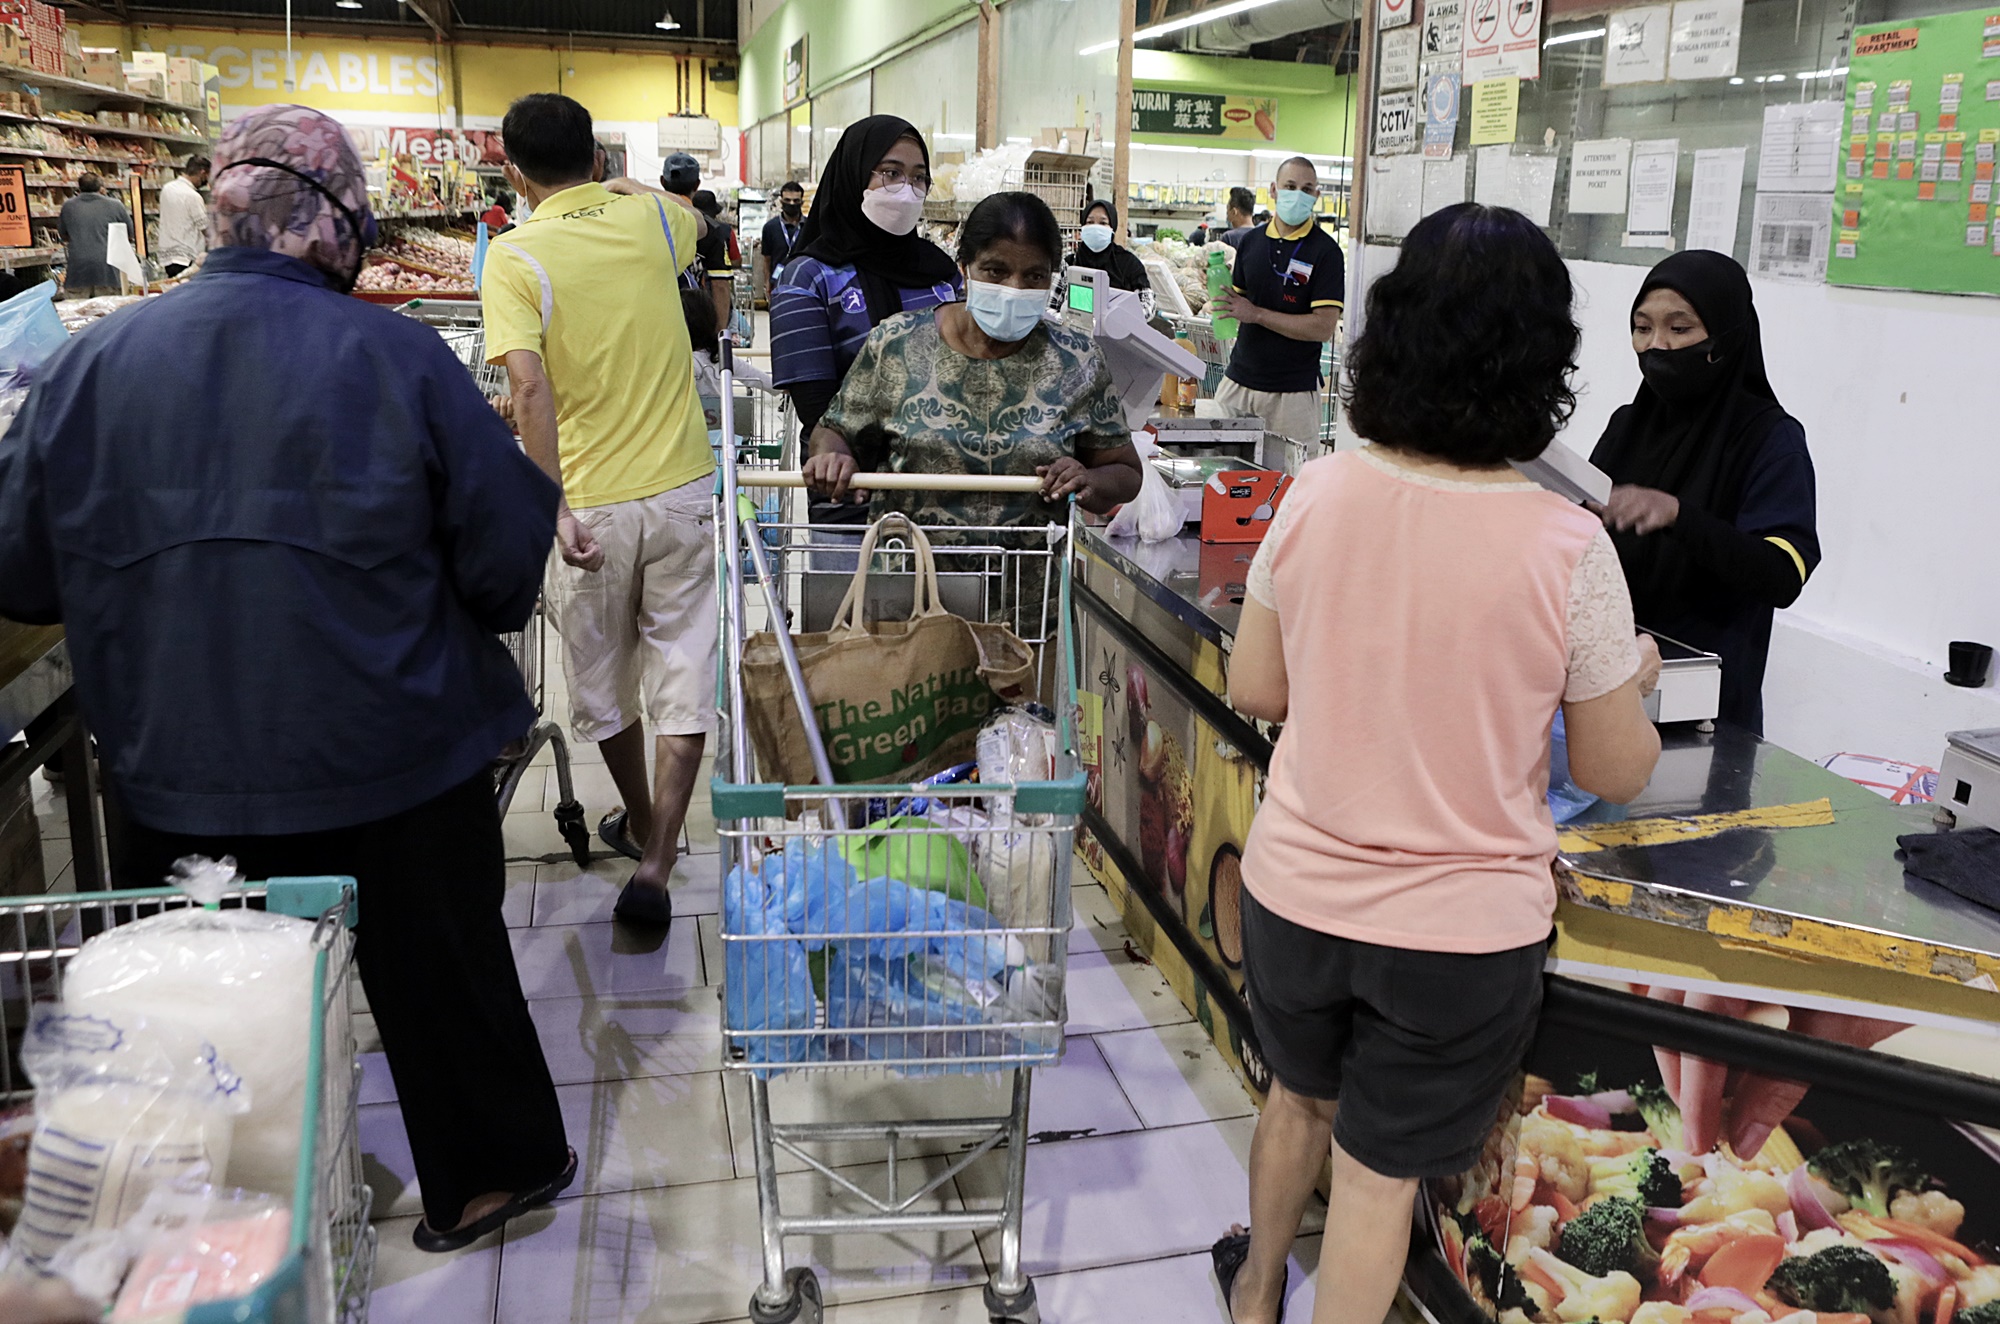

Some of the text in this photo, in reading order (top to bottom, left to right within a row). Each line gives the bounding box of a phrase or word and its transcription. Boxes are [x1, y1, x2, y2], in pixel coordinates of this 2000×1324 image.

[1436, 3, 1459, 17] AWAS
[1870, 31, 1900, 43] RETAIL
[1856, 38, 1916, 55] DEPARTMENT
[140, 42, 446, 97] GETABLES
[1173, 113, 1213, 129] 蔬菜
[1380, 109, 1410, 133] CCTV
[374, 129, 482, 166] Meat
[1576, 168, 1622, 177] BEWARE WITH PICK
[1588, 181, 1607, 189] POCKET
[562, 208, 605, 220] FLEET
[1283, 294, 1297, 303] NSK
[815, 699, 881, 730] The
[829, 714, 927, 766] Green
[933, 691, 989, 728] Bag
